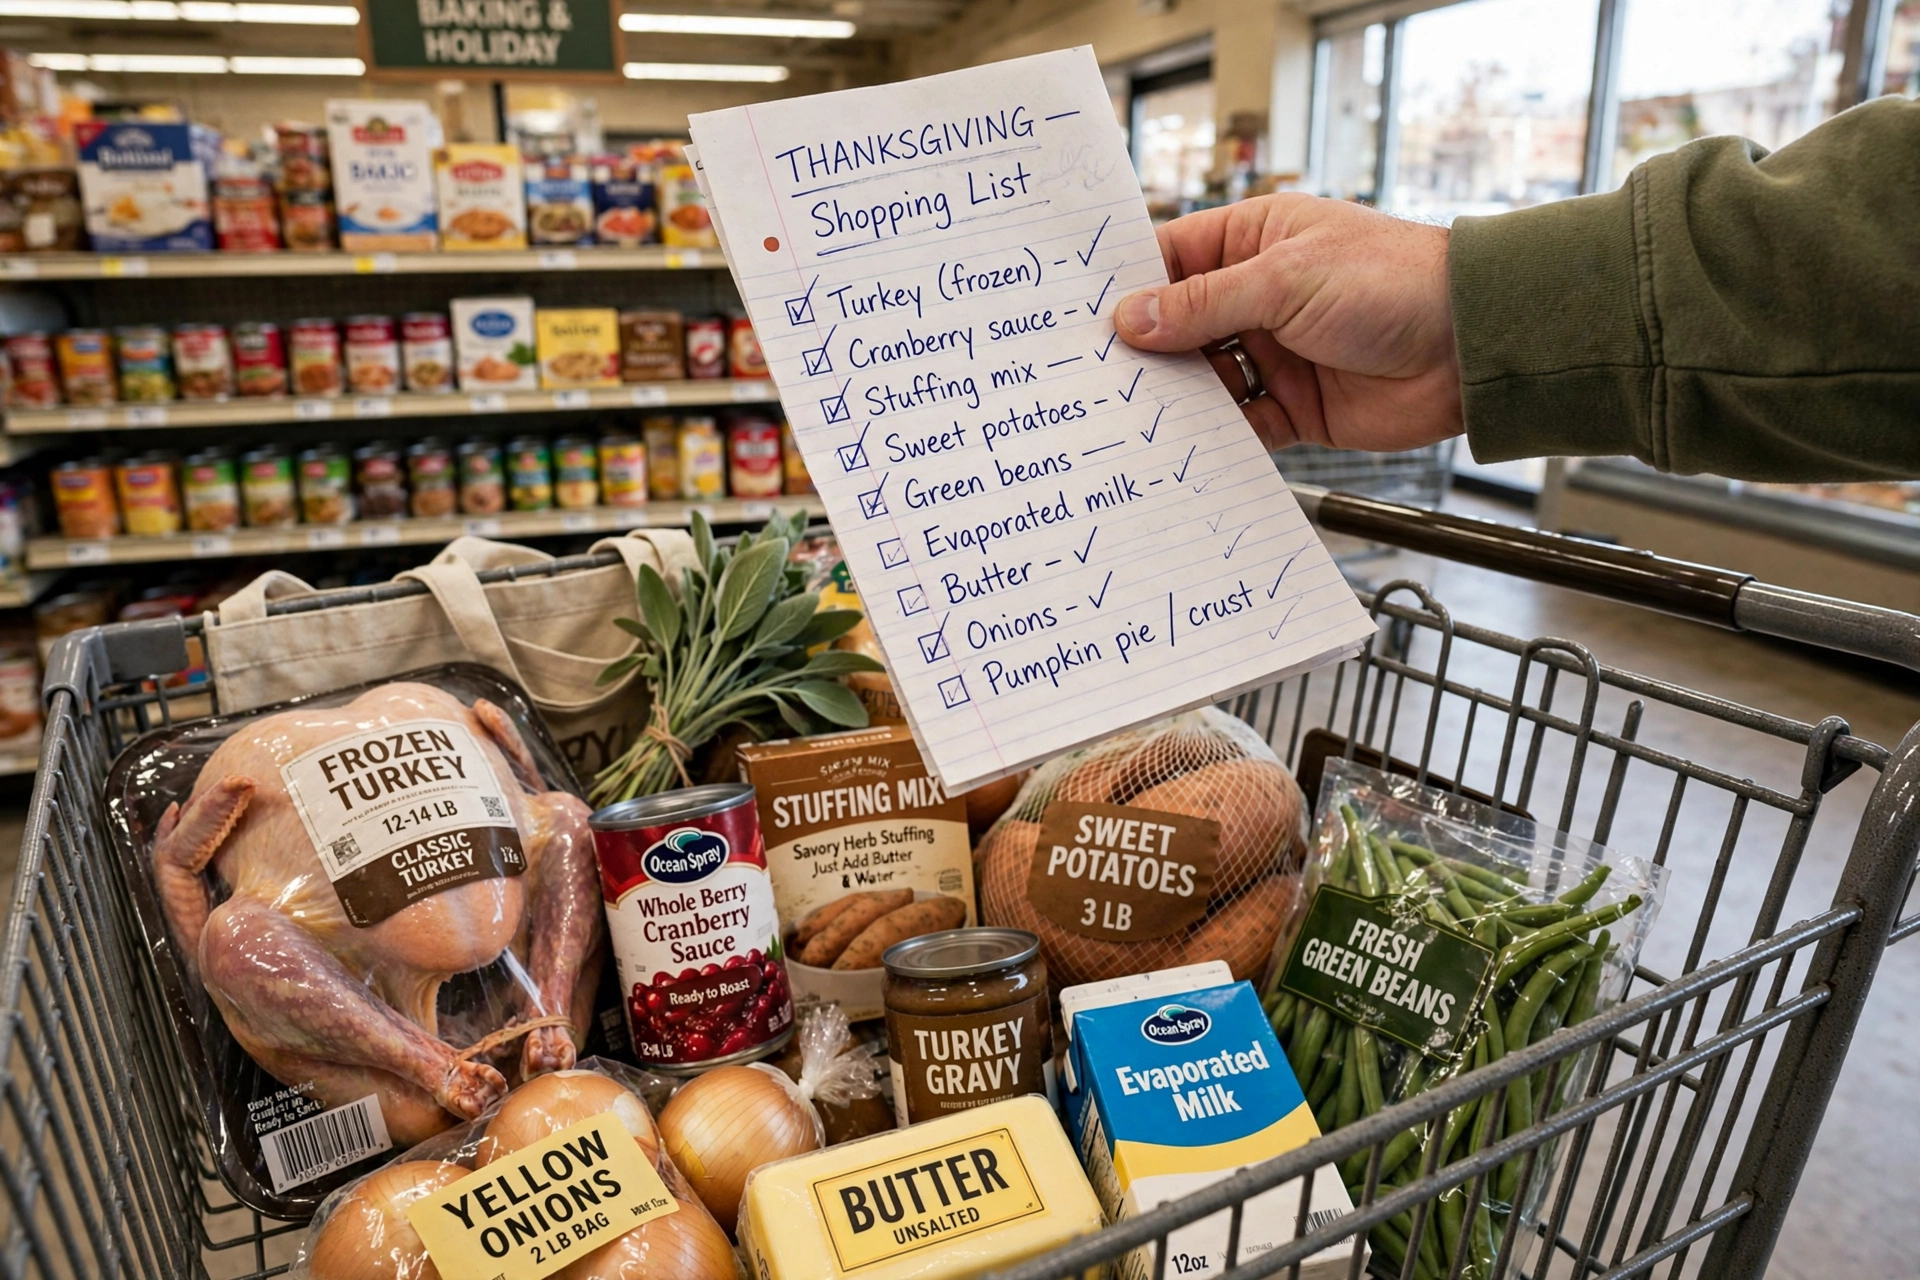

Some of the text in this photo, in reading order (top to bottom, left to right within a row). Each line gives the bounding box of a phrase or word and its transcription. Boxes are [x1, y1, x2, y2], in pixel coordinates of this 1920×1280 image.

[417, 0, 573, 30] BAKING &
[423, 29, 561, 65] HOLIDAY
[775, 106, 1035, 183] THANKSGIVING
[811, 162, 1031, 239] Shopping List
[827, 281, 922, 319] Turkey
[938, 246, 1042, 301] (frozen)
[848, 327, 975, 369] Cranberry
[988, 309, 1058, 341] sauce
[864, 371, 981, 416] Stuffing
[990, 359, 1037, 390] mix
[884, 420, 967, 463] Sweet
[981, 400, 1087, 452] potatoes
[904, 474, 985, 509] Green
[994, 452, 1073, 487] beans
[922, 490, 1075, 558] Evaporated
[1084, 472, 1144, 513] milk
[940, 560, 1033, 606] Butter
[966, 604, 1059, 651] Onions
[982, 639, 1102, 696] Pumpkin
[1115, 623, 1157, 665] pie
[1188, 579, 1254, 629] crust
[318, 729, 456, 783] FROZEN
[868, 755, 892, 769] MIX
[328, 754, 467, 812] TURKEY
[772, 774, 946, 829] STUFFING MIX
[381, 805, 433, 836] 12-14
[432, 799, 459, 819] LB
[1074, 814, 1177, 857] SWEET
[390, 831, 472, 870] CLASSIC
[649, 845, 722, 874] Ocean Spray
[792, 825, 935, 861] Savory Herb Stuffing
[812, 850, 913, 879] Just Add Butter
[397, 847, 475, 888] TURKEY
[854, 870, 895, 887] Water
[1047, 845, 1198, 898] POTATOES
[637, 882, 748, 919] Whole Berry
[643, 904, 750, 943] Cranberry
[1080, 897, 1133, 931] 3 LB
[670, 934, 737, 964] Sauce
[1346, 917, 1426, 973] FRESH
[669, 977, 751, 1007] Ready to Roast
[1301, 937, 1372, 989] GREEN
[1367, 963, 1457, 1026] BEANS
[913, 1016, 1025, 1062] TURKEY
[1148, 1016, 1206, 1037] Ocean Spray
[925, 1052, 1022, 1095] GRAVY
[1115, 1039, 1271, 1097] Evaporated
[1171, 1083, 1243, 1123] Milk
[441, 1129, 609, 1230] YELLOW
[839, 1147, 1011, 1235] BUTTER
[479, 1169, 622, 1259] ONIONS
[892, 1206, 981, 1245] UNSALTED
[530, 1212, 611, 1265] 2 LB BAG
[1171, 1252, 1210, 1275] 12oz
